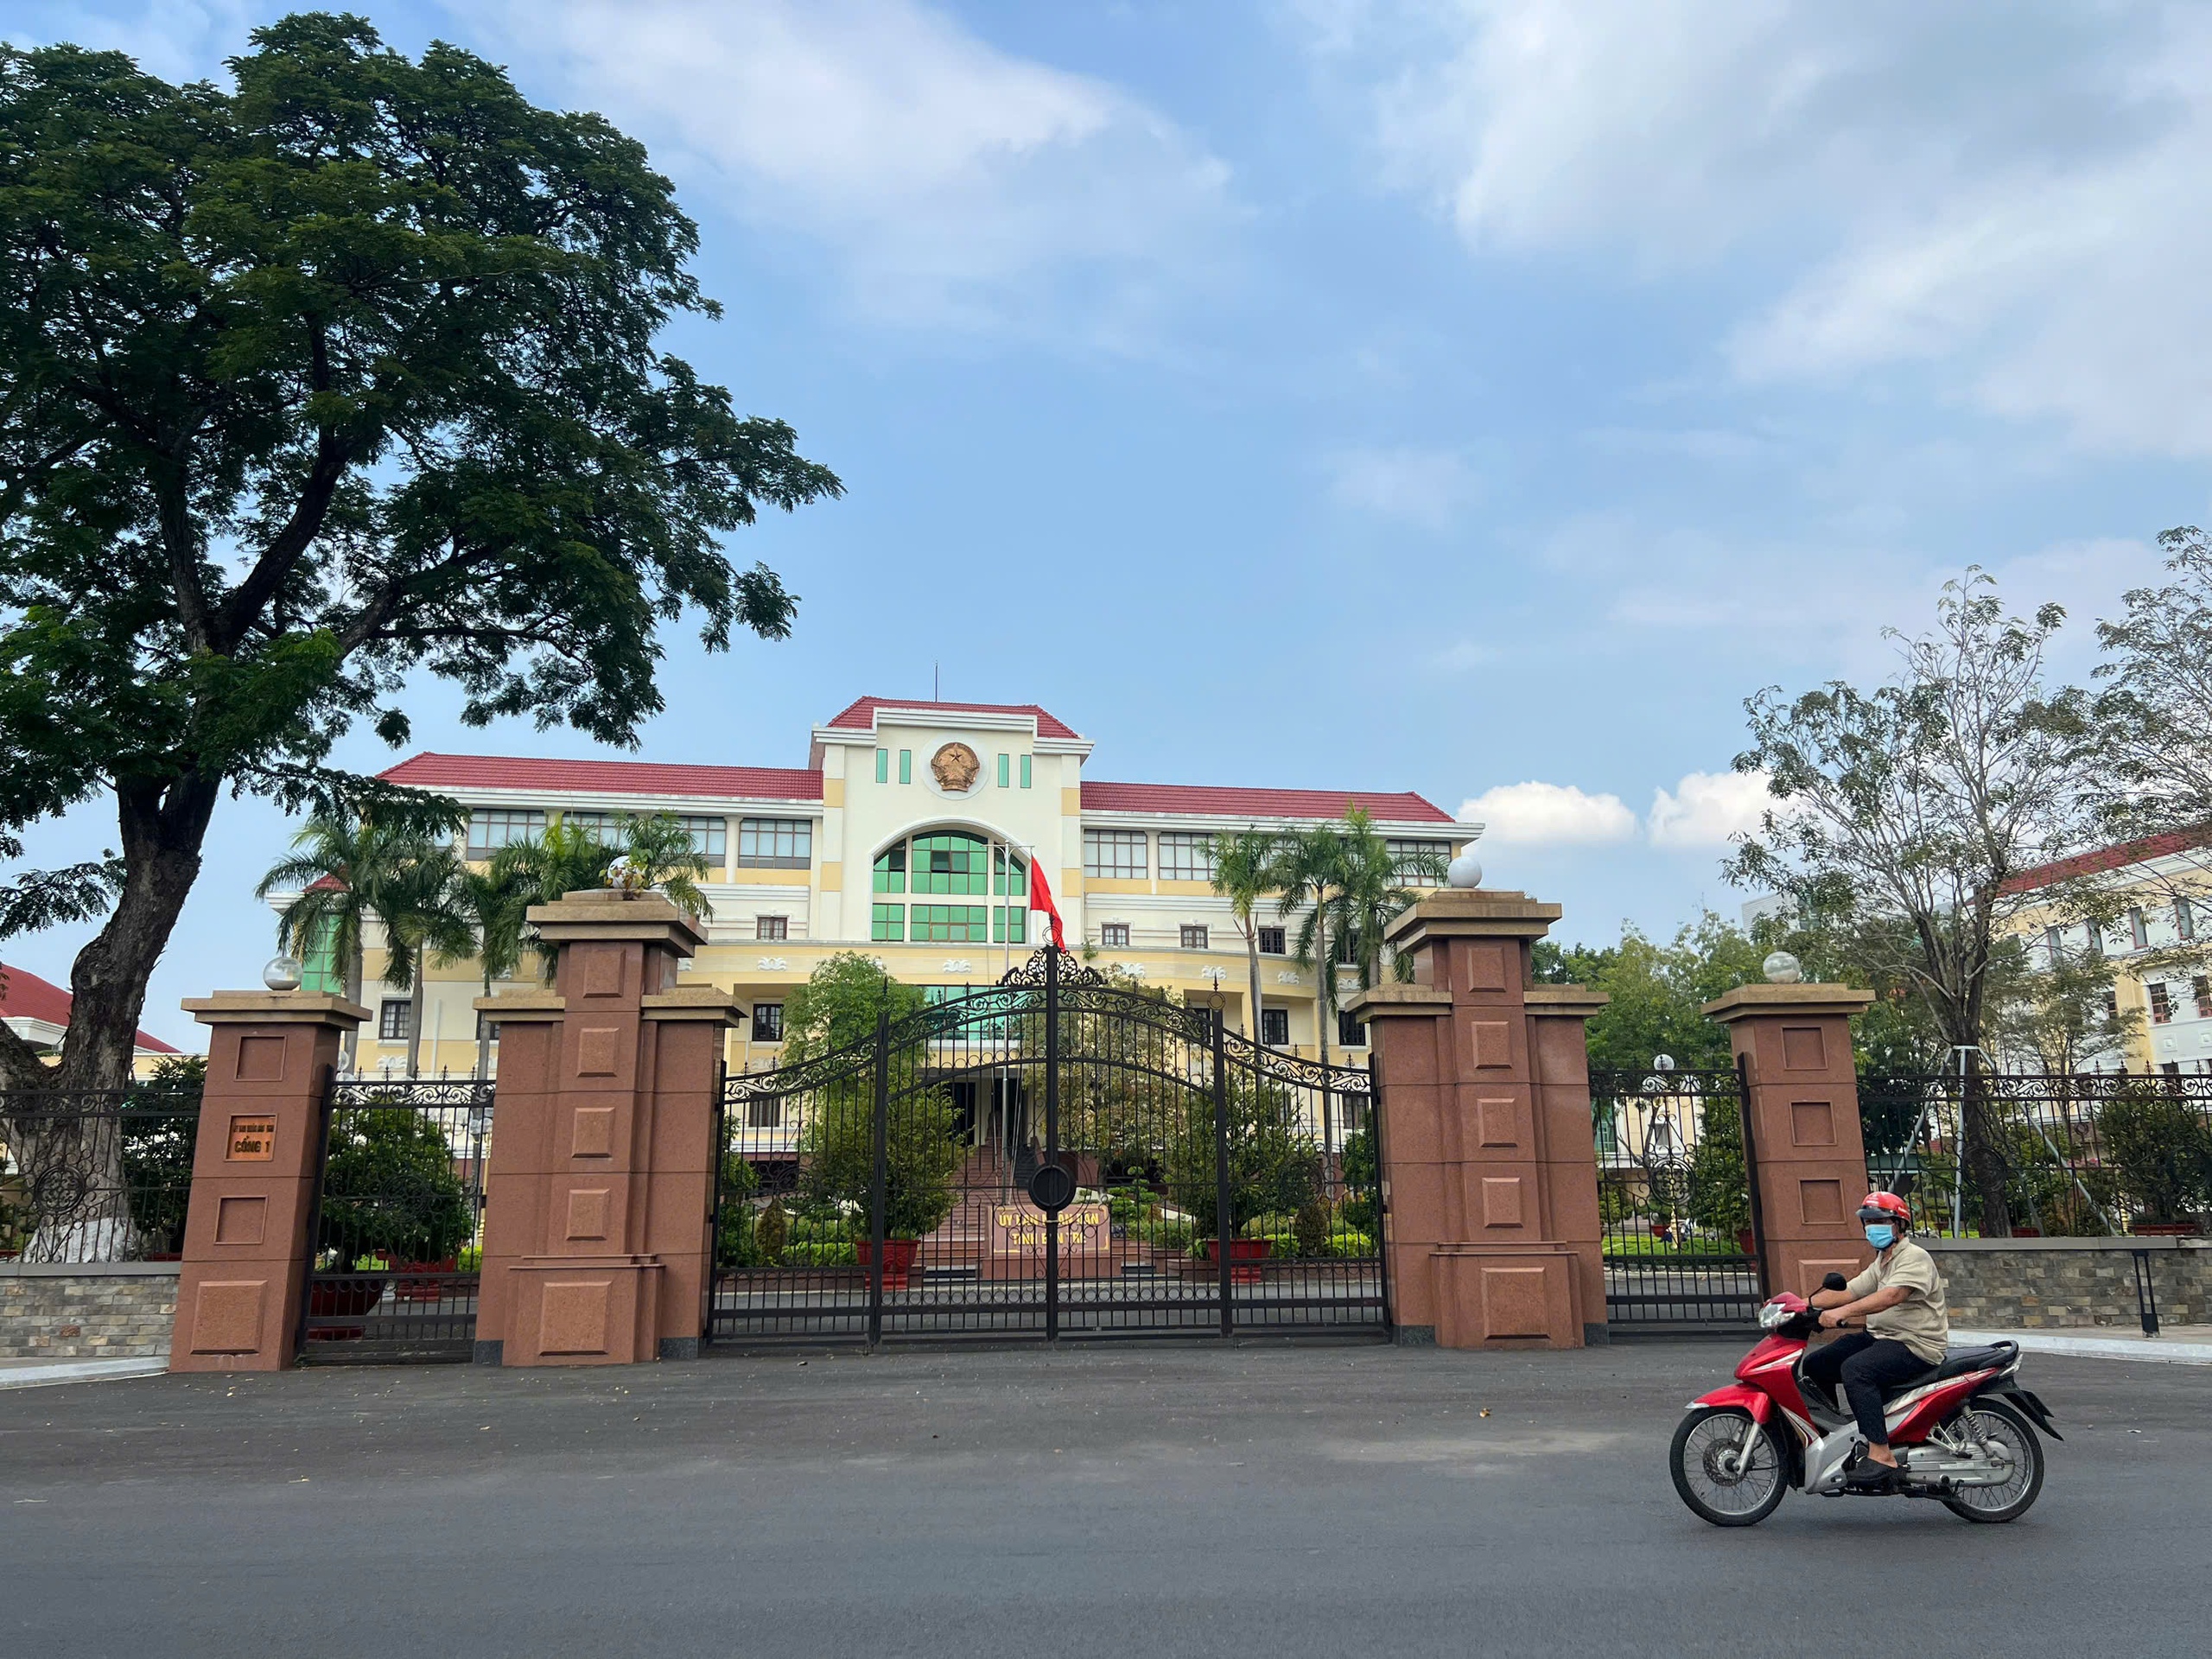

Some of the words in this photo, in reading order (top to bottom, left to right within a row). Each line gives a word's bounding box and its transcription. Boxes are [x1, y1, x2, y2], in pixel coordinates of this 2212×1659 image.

[265, 1141, 270, 1153] 1
[1041, 1211, 1073, 1226] NÂN
[1041, 1232, 1064, 1244] BN
